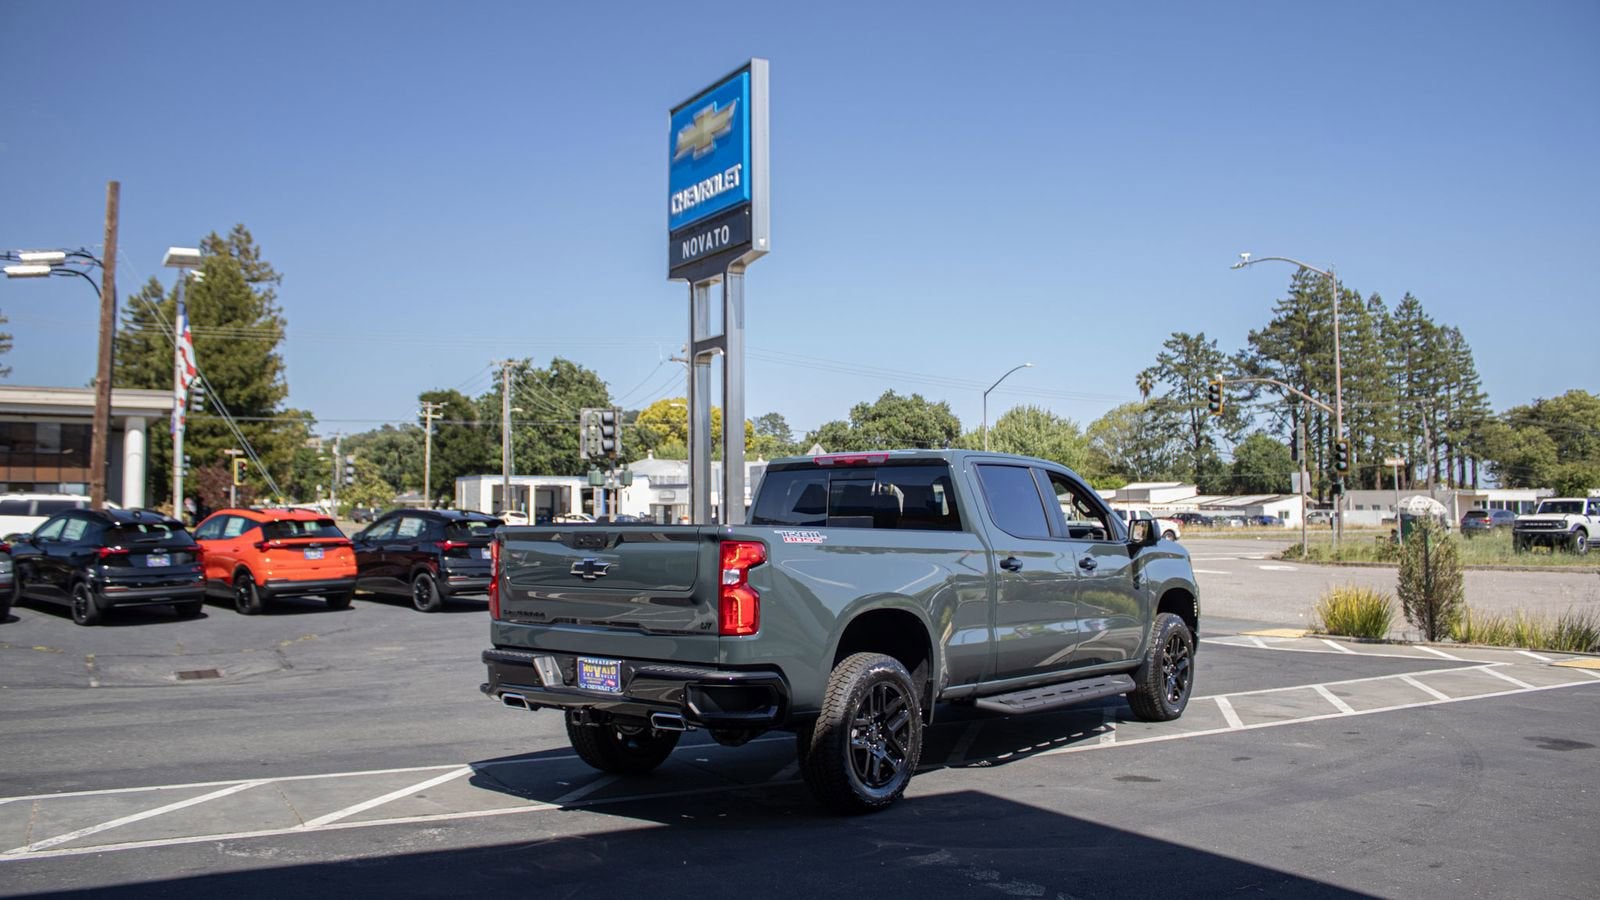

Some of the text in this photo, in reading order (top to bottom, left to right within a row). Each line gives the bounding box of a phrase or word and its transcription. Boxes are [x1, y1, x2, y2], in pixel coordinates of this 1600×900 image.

[671, 163, 742, 215] CHEVROLET
[682, 225, 730, 260] NOVATO
[583, 664, 616, 678] NOVATO
